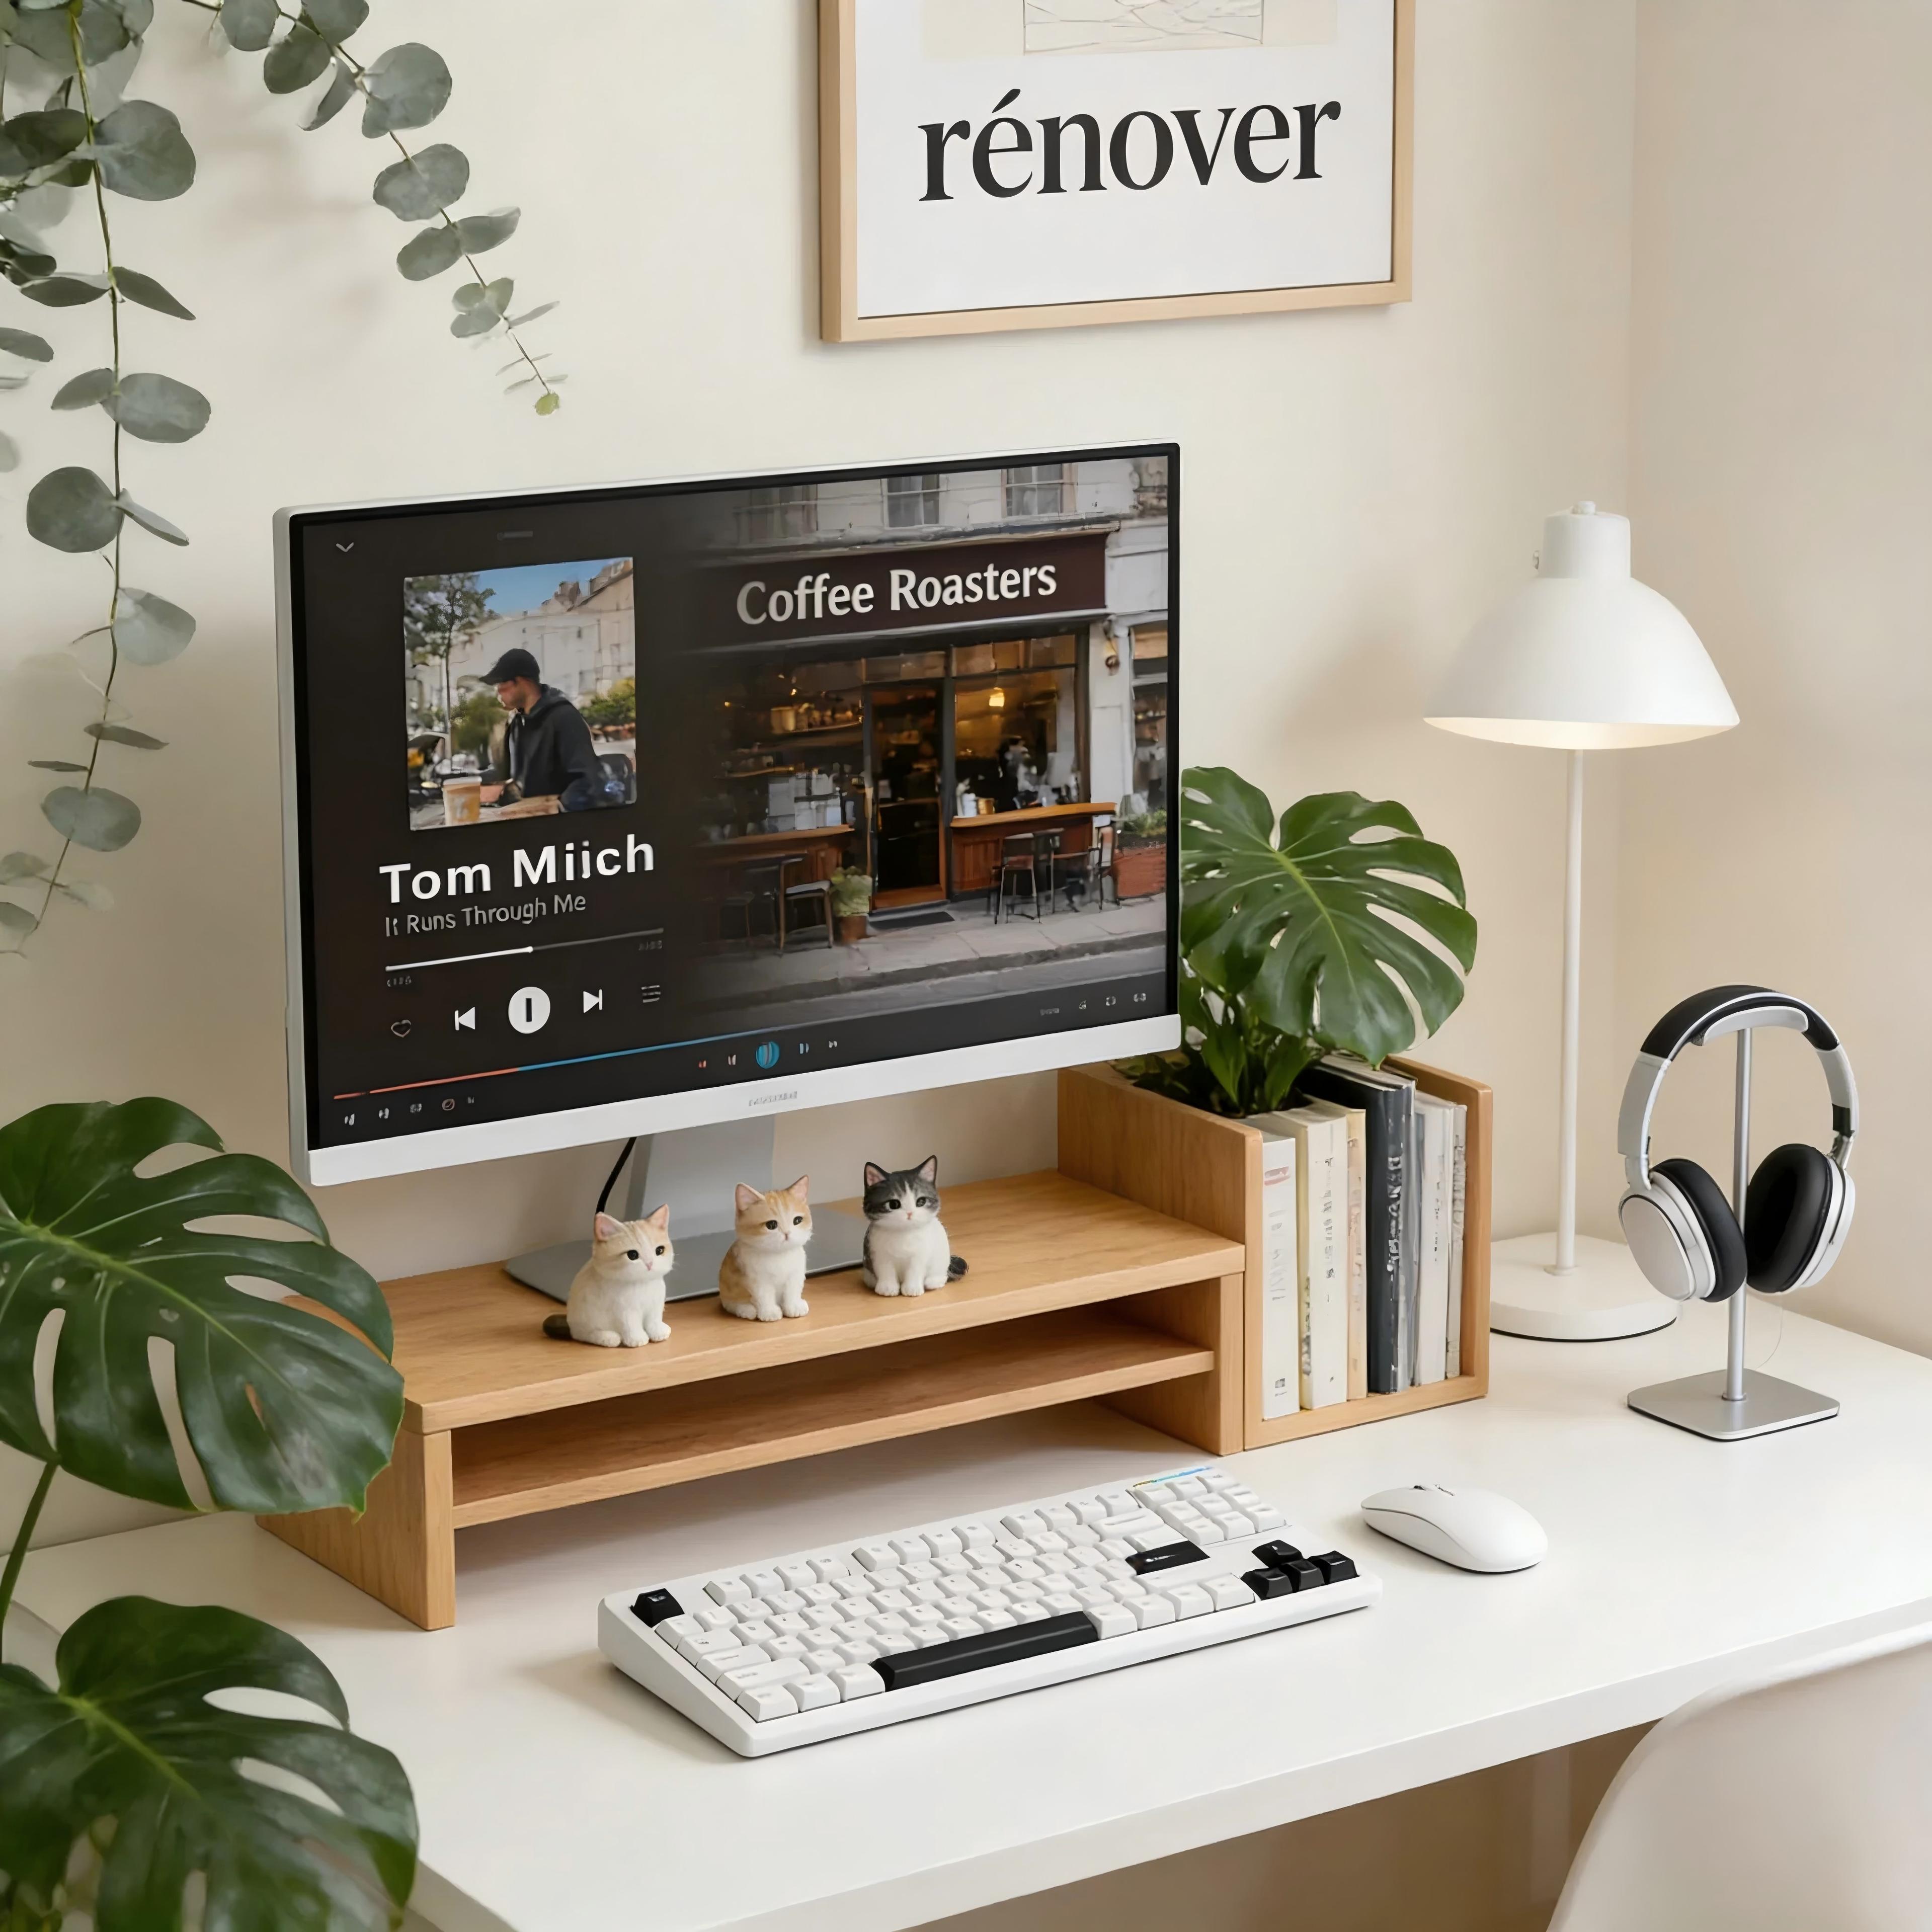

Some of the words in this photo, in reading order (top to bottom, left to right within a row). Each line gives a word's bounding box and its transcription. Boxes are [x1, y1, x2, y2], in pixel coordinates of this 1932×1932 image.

[918, 89, 1341, 201] rénover
[737, 573, 874, 624] Coffee
[890, 564, 1056, 611] Roasters
[379, 863, 491, 903] Tom
[407, 913, 456, 934] Runs
[461, 898, 546, 926] Through
[554, 894, 586, 914] Me
